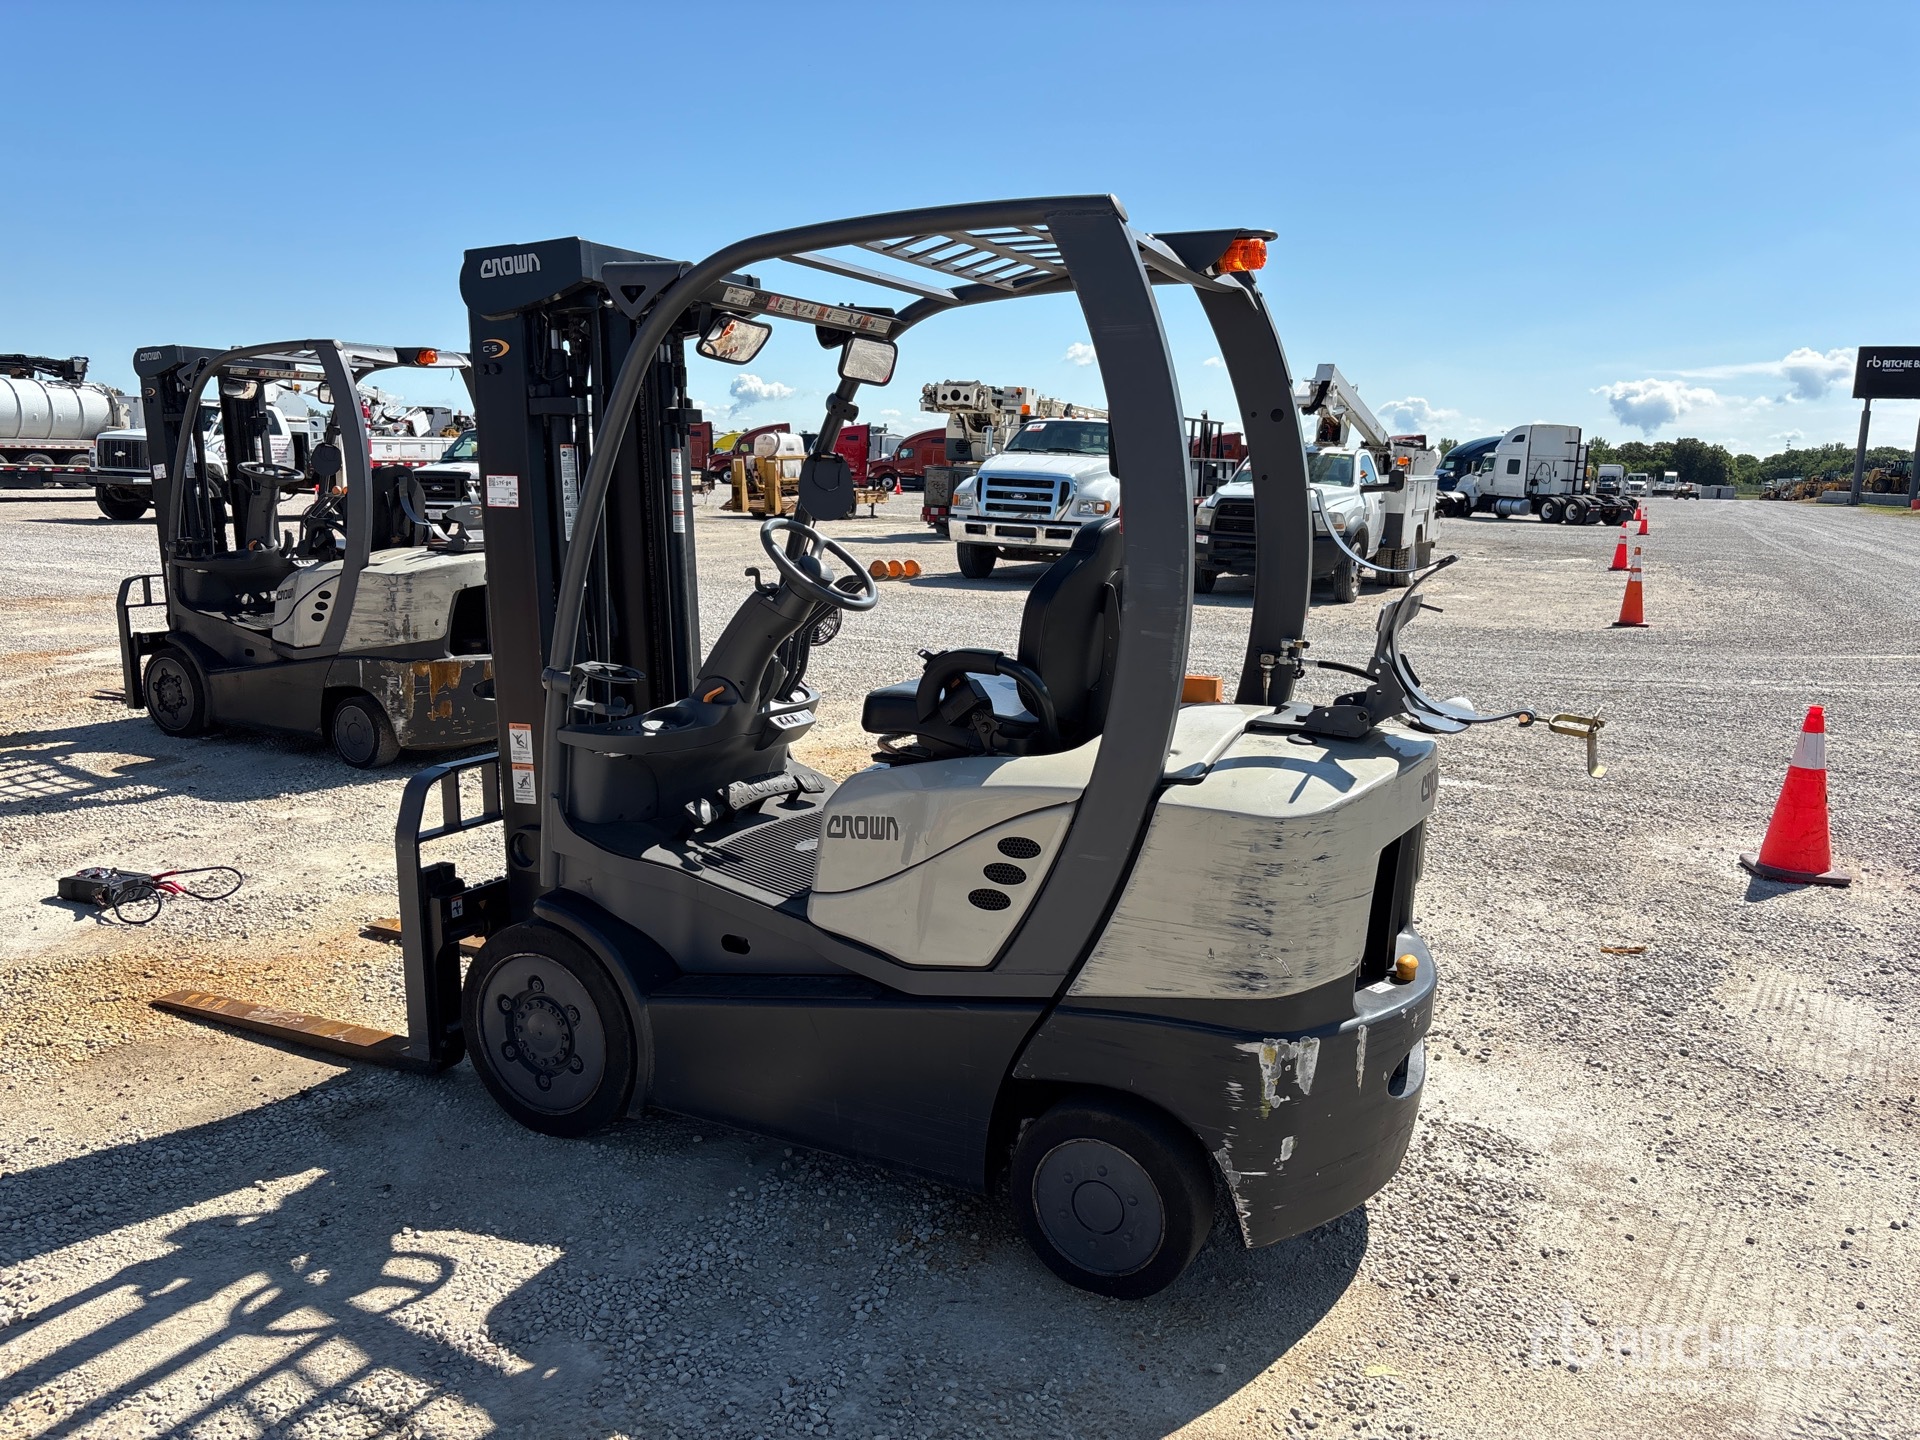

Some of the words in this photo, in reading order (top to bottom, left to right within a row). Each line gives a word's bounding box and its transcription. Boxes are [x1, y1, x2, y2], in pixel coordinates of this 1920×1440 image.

[480, 253, 542, 279] CROWN
[1866, 355, 1882, 368] rb
[1882, 360, 1913, 368] RITCHIE
[826, 815, 899, 841] CROWN
